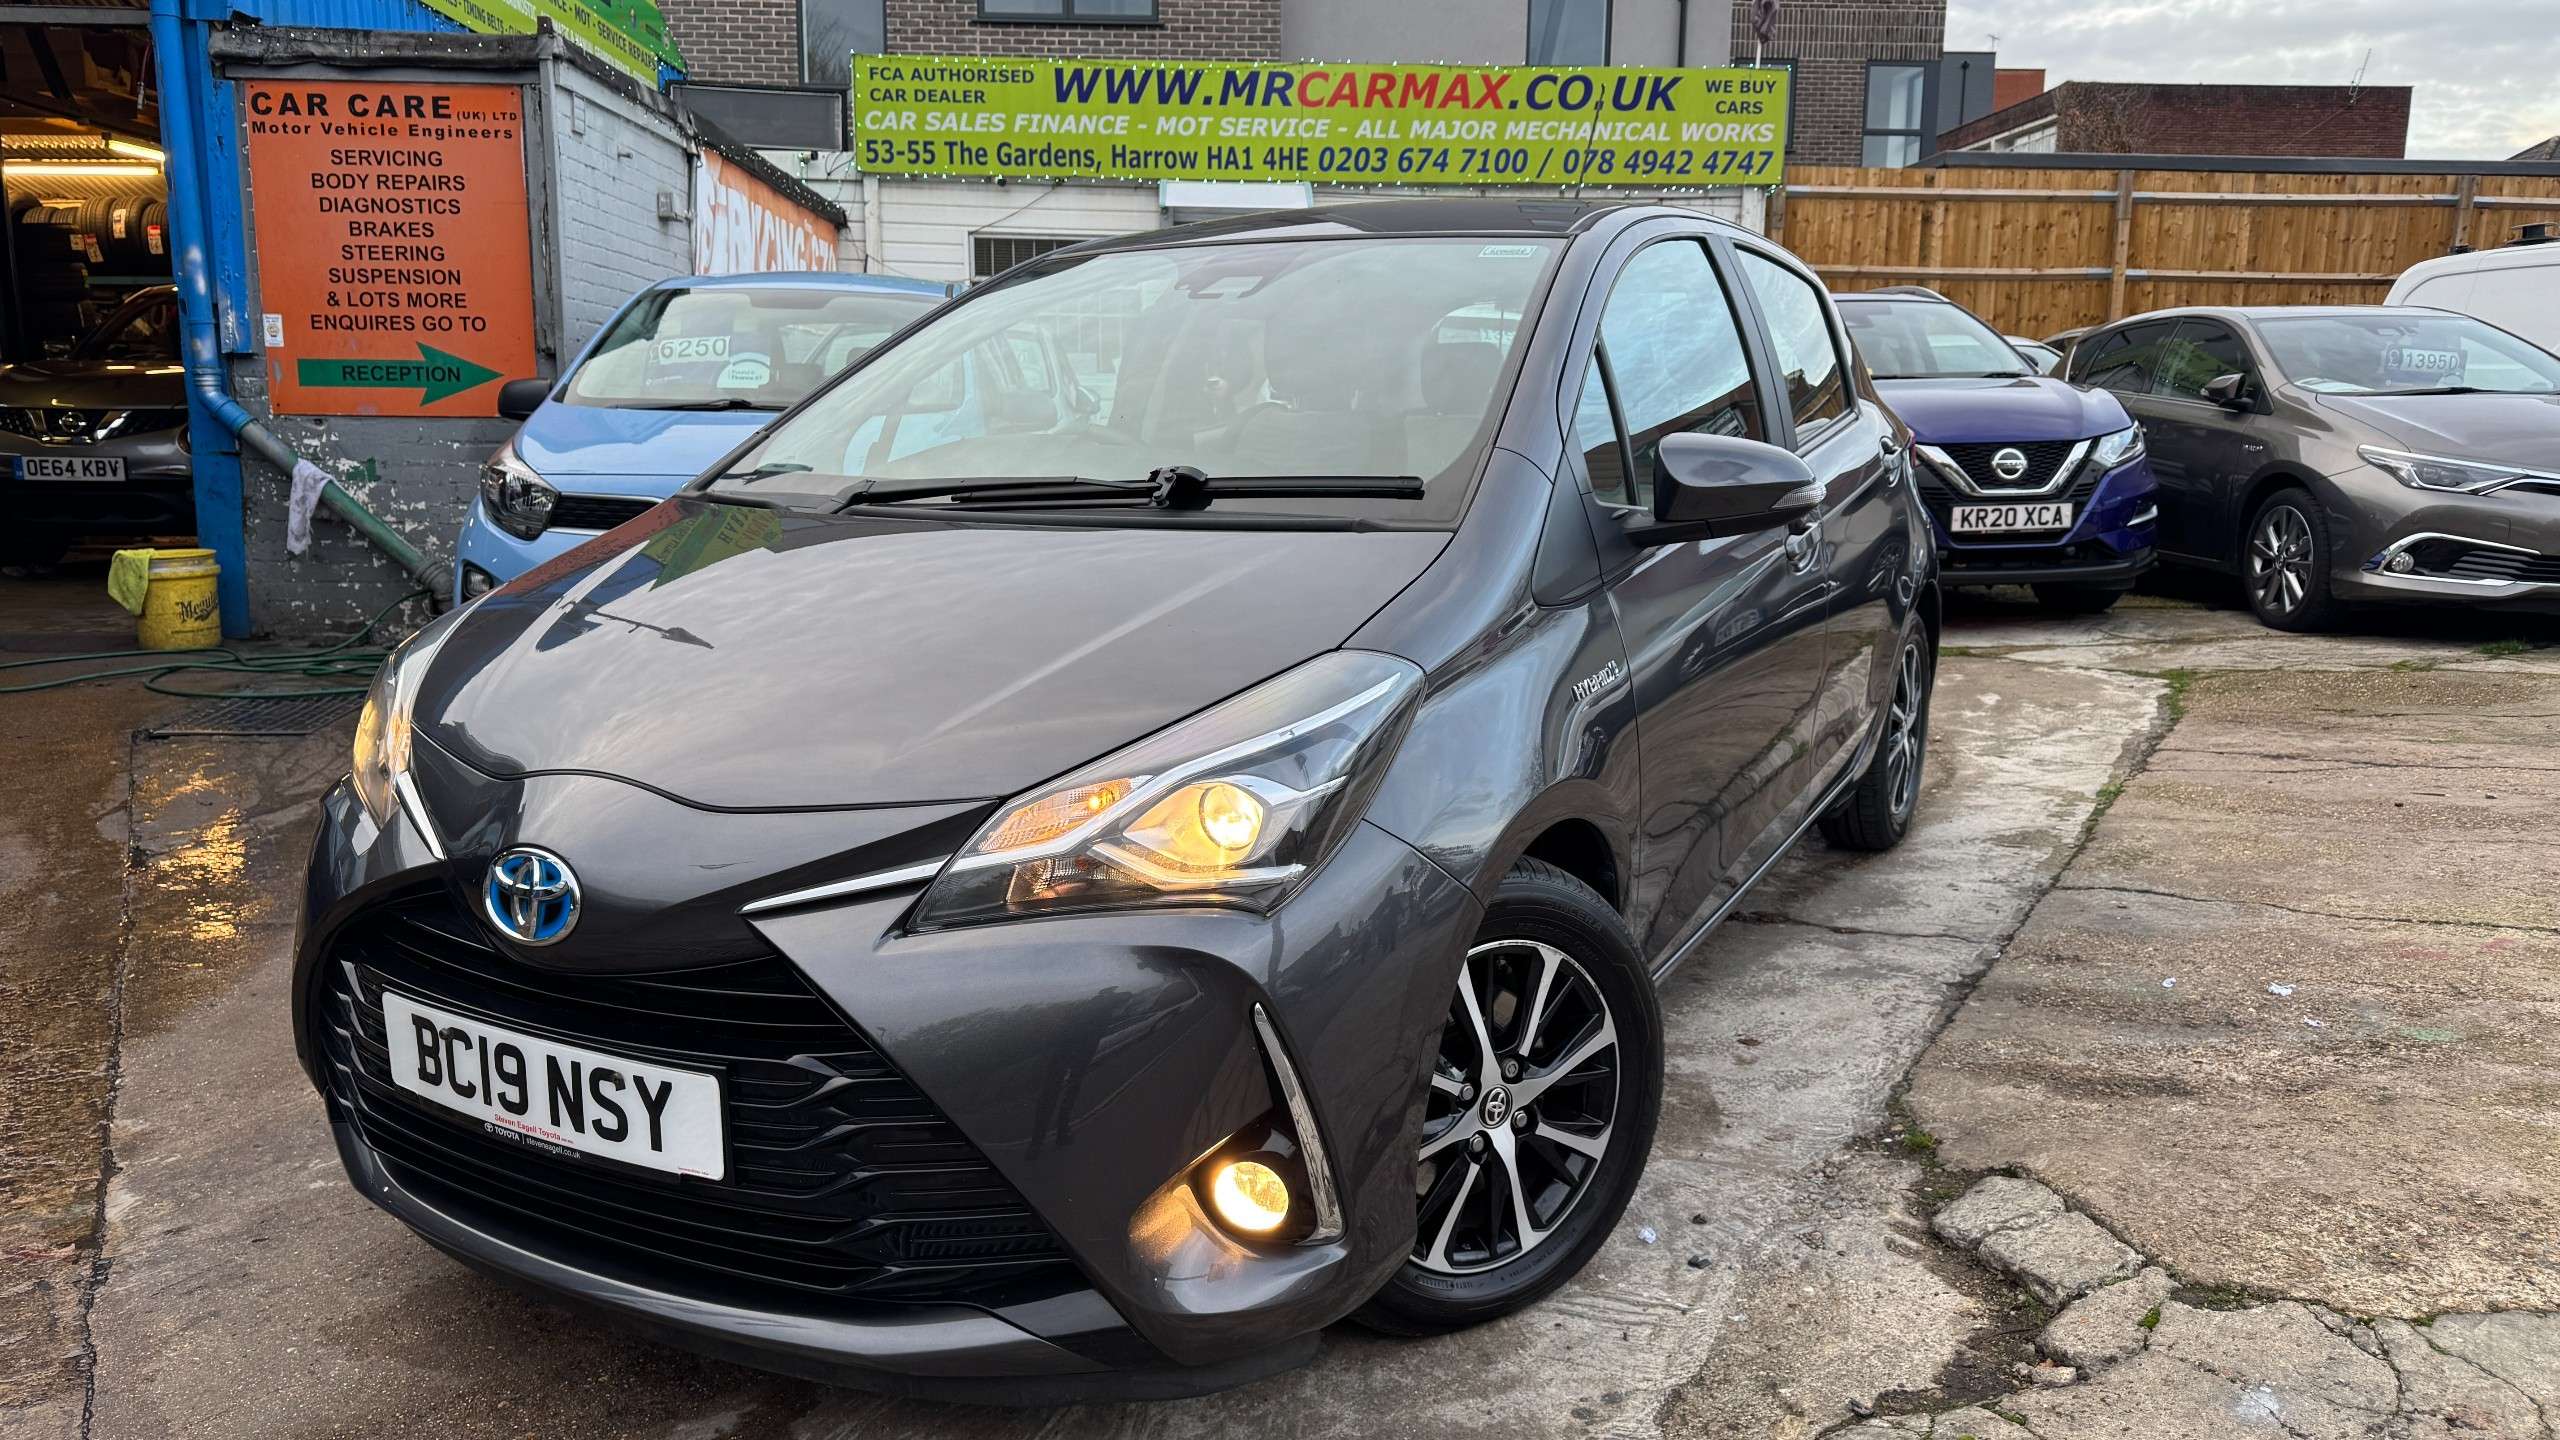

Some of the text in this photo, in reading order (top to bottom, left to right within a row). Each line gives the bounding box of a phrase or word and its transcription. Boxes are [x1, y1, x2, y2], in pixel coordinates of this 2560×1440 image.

[464, 0, 486, 24] TIMING
[486, 11, 504, 34] BELTS
[575, 4, 590, 28] MOT
[598, 20, 627, 53] SERVICE
[628, 41, 656, 71] REPAIRS
[869, 67, 1034, 84] FCA AUTHORISED
[870, 88, 986, 104] CAR DEALER
[1054, 67, 1684, 112] WWW.MRCARMAX.CO.UK
[1705, 80, 1777, 94] WE BUY
[251, 92, 517, 121] CAR CARE (UK) LTD
[1715, 100, 1764, 115] CARS
[251, 121, 513, 141] Motor Vehicle Engineers
[864, 111, 917, 131] CAR
[924, 112, 1007, 132] SALES
[1014, 113, 1130, 135] FINANCE
[1156, 116, 1214, 136] MOT
[1219, 117, 1331, 138] SERVICE
[1354, 119, 1401, 139] ALL
[1409, 120, 1497, 140] MAJOR
[1504, 121, 1671, 142] MECHANICAL
[1680, 122, 1775, 143] WORKS
[330, 149, 443, 167] SERVICING
[866, 139, 936, 165] 53-55
[944, 141, 989, 166] The
[997, 142, 1102, 174] Gardens,
[1111, 144, 1198, 169] Harrow
[1207, 146, 1253, 170] HA1
[1263, 147, 1309, 171] 4HE
[1318, 146, 1388, 173] 0203
[1397, 148, 1449, 173] 674
[1459, 148, 1529, 174] 7100
[1562, 149, 1616, 174] 078
[1623, 149, 1694, 175] 4942
[1702, 150, 1774, 175] 4747
[311, 173, 465, 192] BODY REPAIRS
[319, 197, 461, 215] DIAGNOSTICS
[349, 221, 434, 238] BRAKES
[341, 245, 445, 262] STEERING
[328, 268, 461, 286] SUSPENSION
[326, 291, 467, 309] & LOTS MORE
[310, 315, 487, 332] ENQUIRES GO TO
[660, 338, 728, 359] 6250
[341, 366, 461, 383] RECEPTION
[26, 458, 119, 478] OE64 KBV
[1960, 506, 2063, 529] KR20 XCA
[411, 1013, 672, 1152] BC19 NSY
[494, 1114, 516, 1127] Steven
[539, 1127, 561, 1141] Toyota
[494, 1126, 520, 1141] TOYOTA
